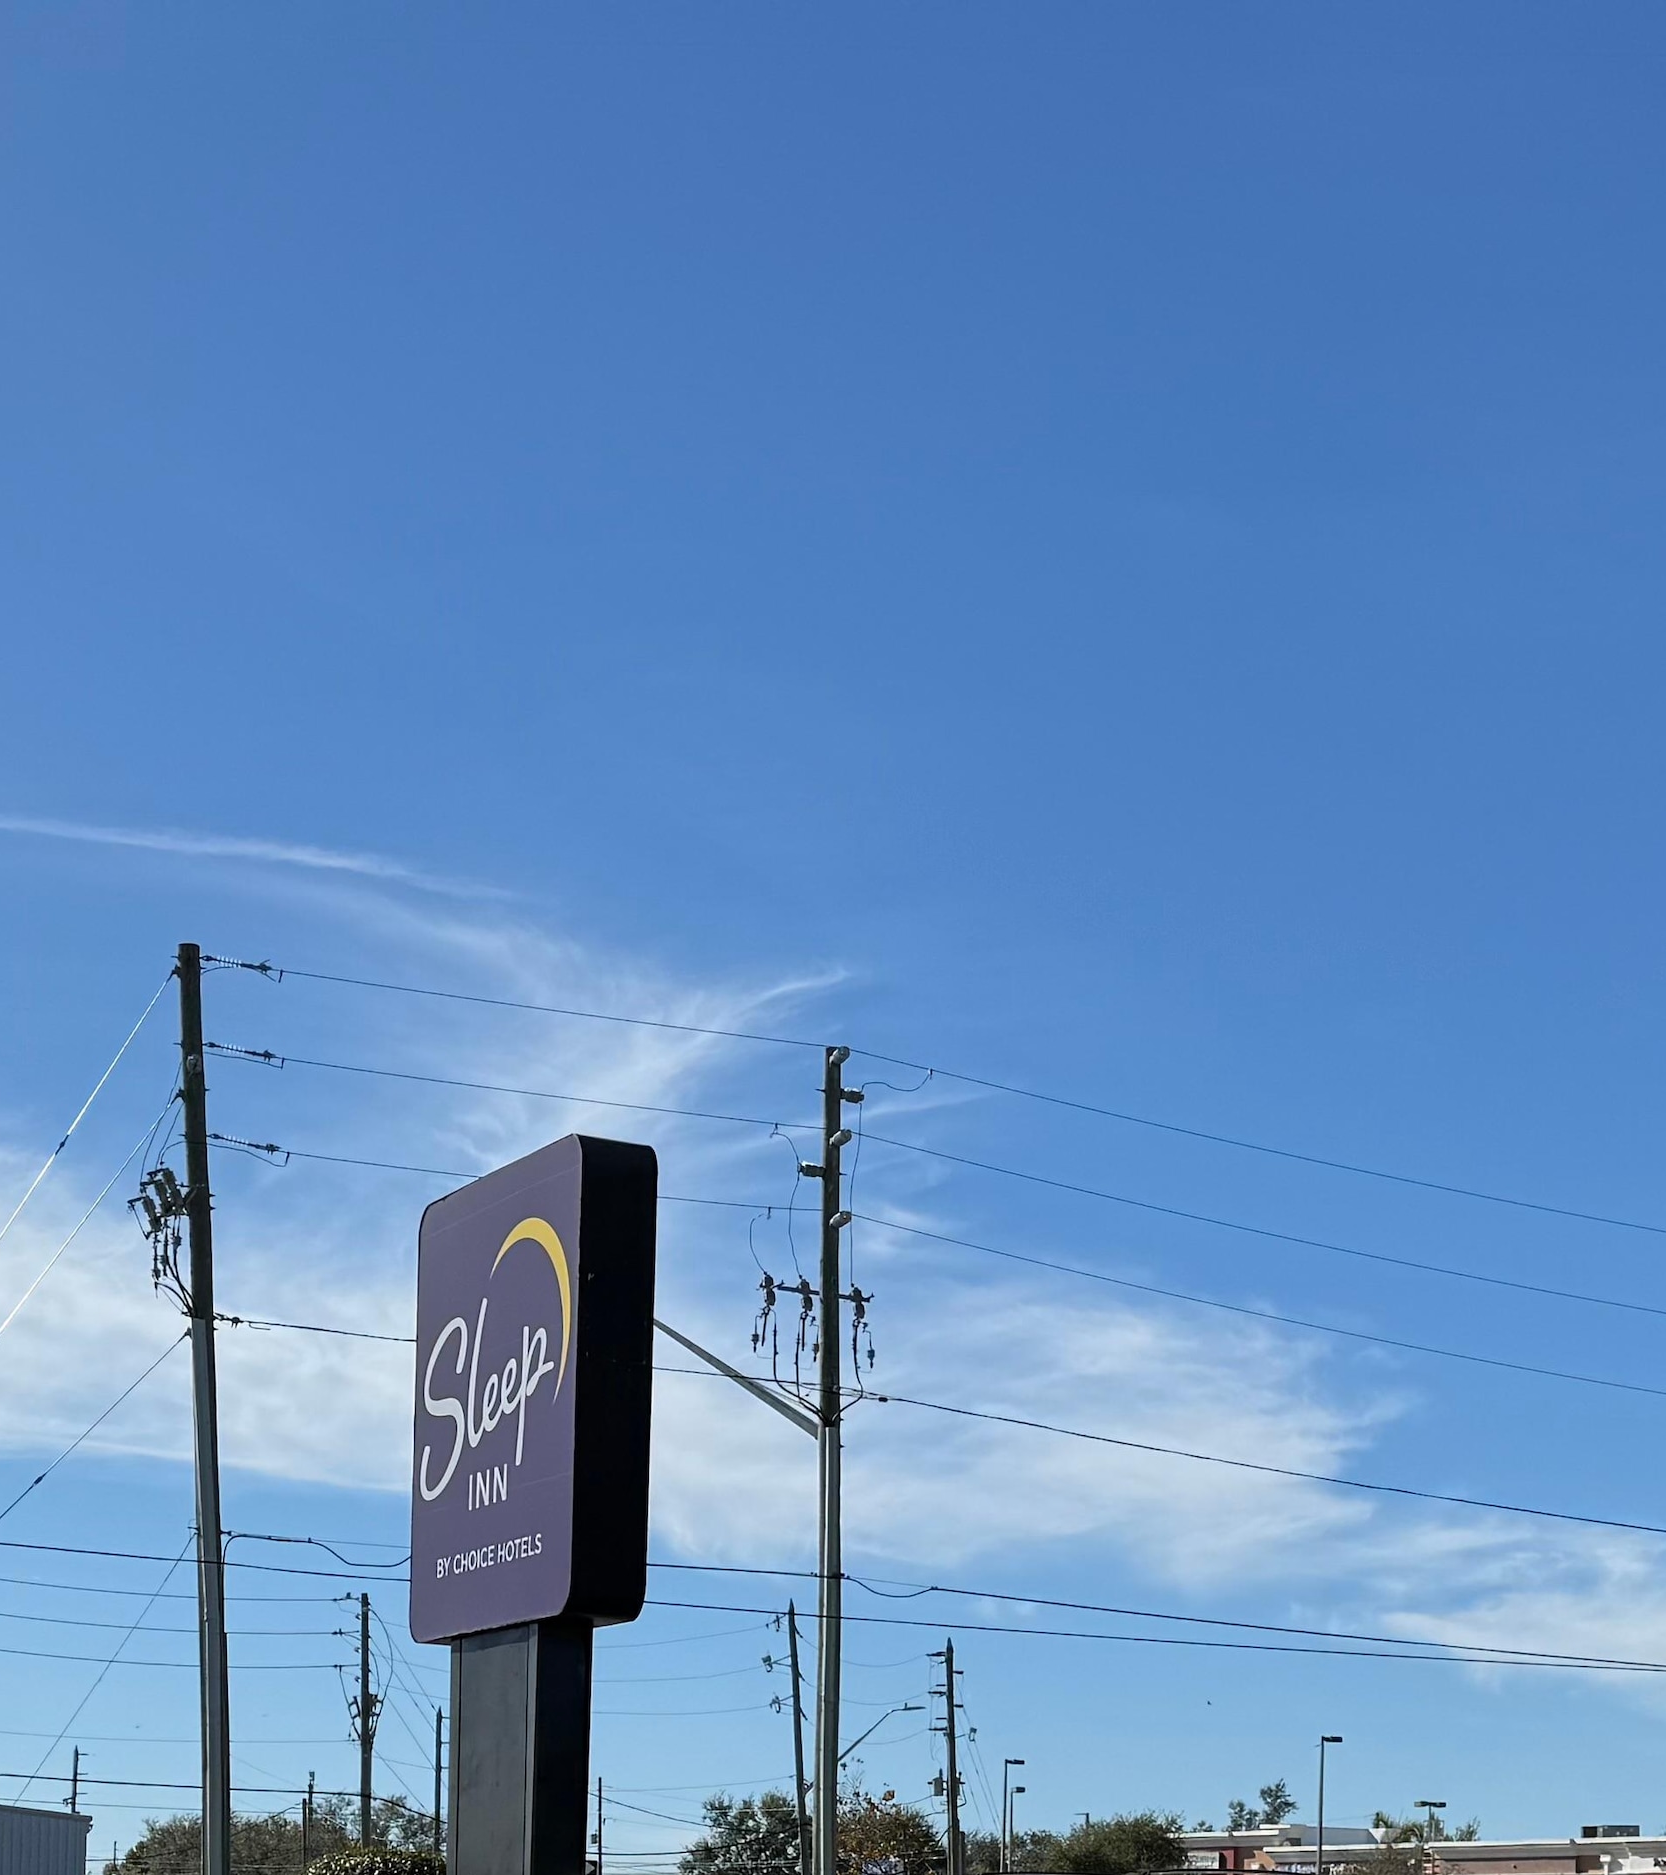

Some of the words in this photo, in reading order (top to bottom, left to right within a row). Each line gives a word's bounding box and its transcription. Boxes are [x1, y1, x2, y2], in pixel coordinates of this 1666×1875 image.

[419, 1297, 555, 1501] Sleep
[468, 1463, 508, 1511] INN
[436, 1556, 451, 1579] BY
[453, 1544, 495, 1575] CHOICE
[497, 1533, 542, 1564] HOTELS
